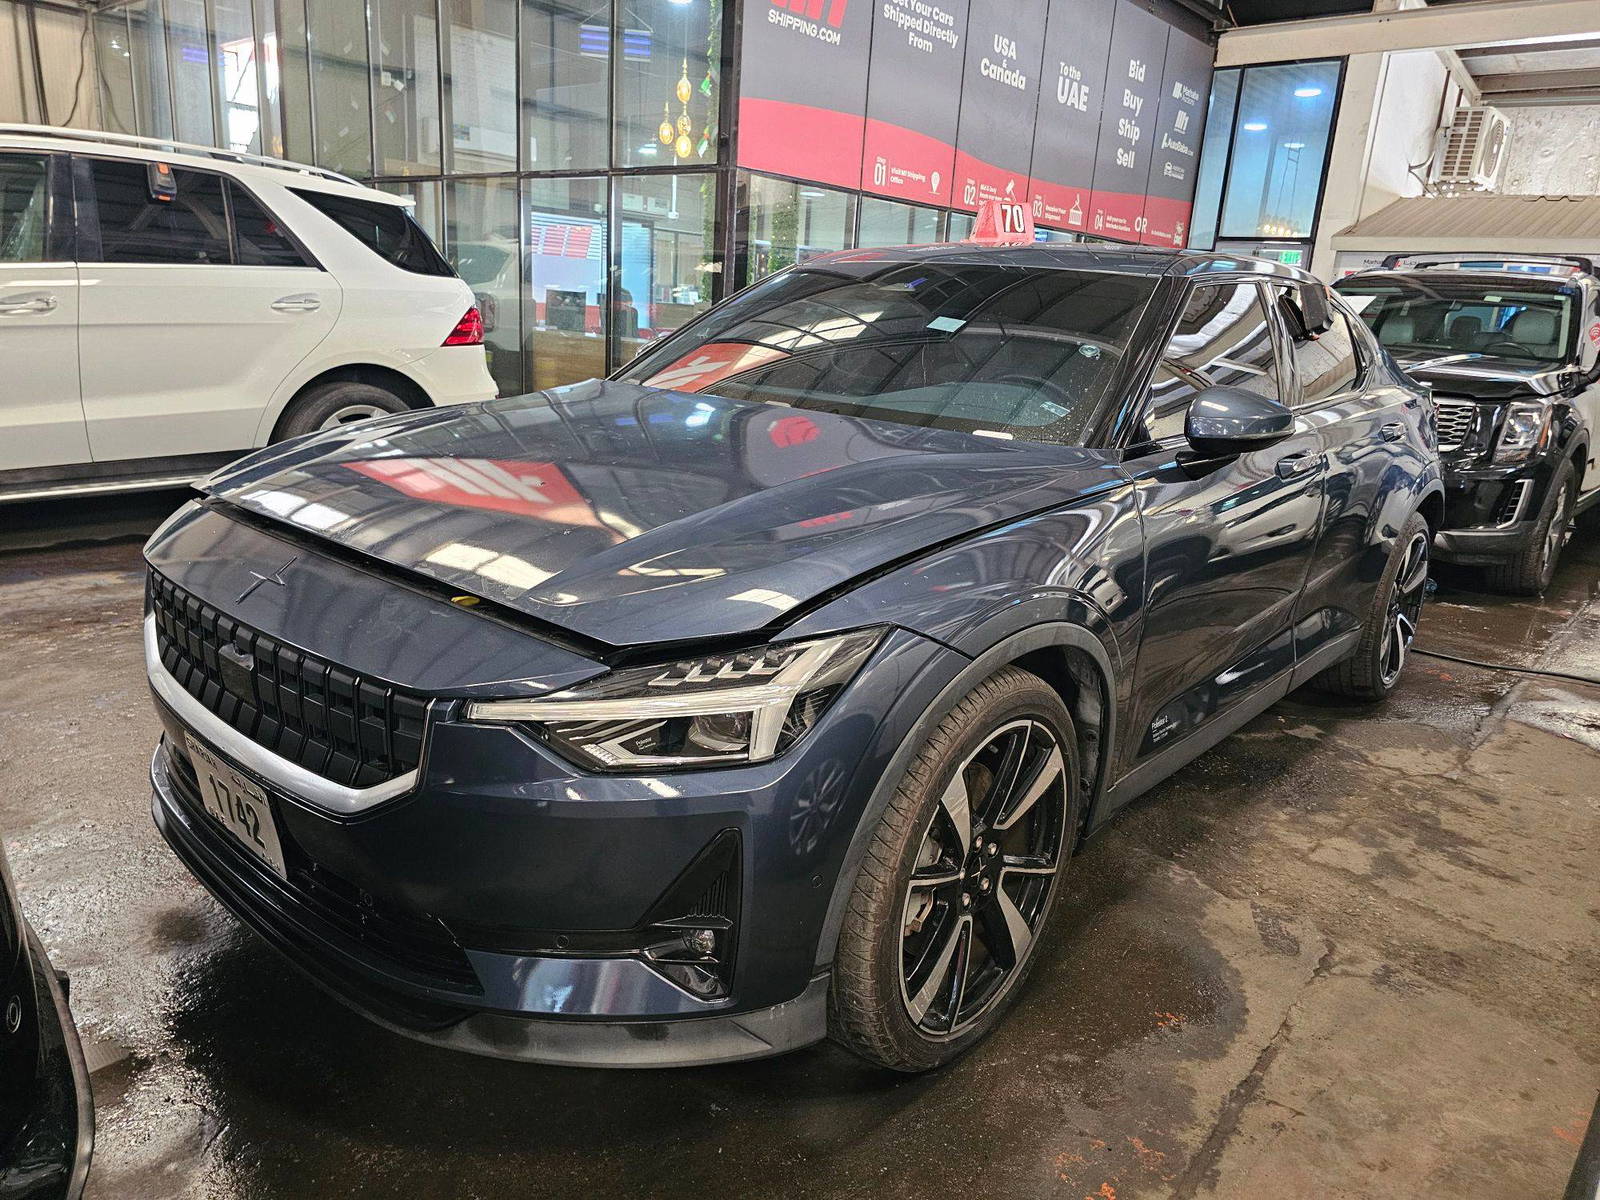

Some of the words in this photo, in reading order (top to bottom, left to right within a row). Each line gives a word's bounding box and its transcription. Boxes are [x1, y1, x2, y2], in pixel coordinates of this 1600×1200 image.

[884, 4, 923, 31] Shipped
[923, 20, 958, 48] Directly
[910, 0, 932, 17] Your
[933, 7, 954, 26] Cars
[768, 9, 841, 45] SHIPPING.COM
[908, 32, 933, 53] From
[994, 34, 1016, 60] USA
[981, 58, 1026, 90] Canada
[1060, 62, 1069, 76] To
[1069, 65, 1081, 80] the
[1129, 60, 1146, 82] Bid
[1057, 76, 1089, 112] UAE
[1123, 89, 1144, 117] Buy
[1119, 118, 1140, 146] Ship
[1117, 148, 1135, 169] Sell
[874, 163, 886, 187] 01
[964, 185, 976, 206] 02
[1033, 200, 1043, 217] 03
[1001, 204, 1024, 233] 70
[1094, 214, 1103, 231] 04
[1134, 216, 1148, 234] OR
[209, 774, 268, 851] 1742
